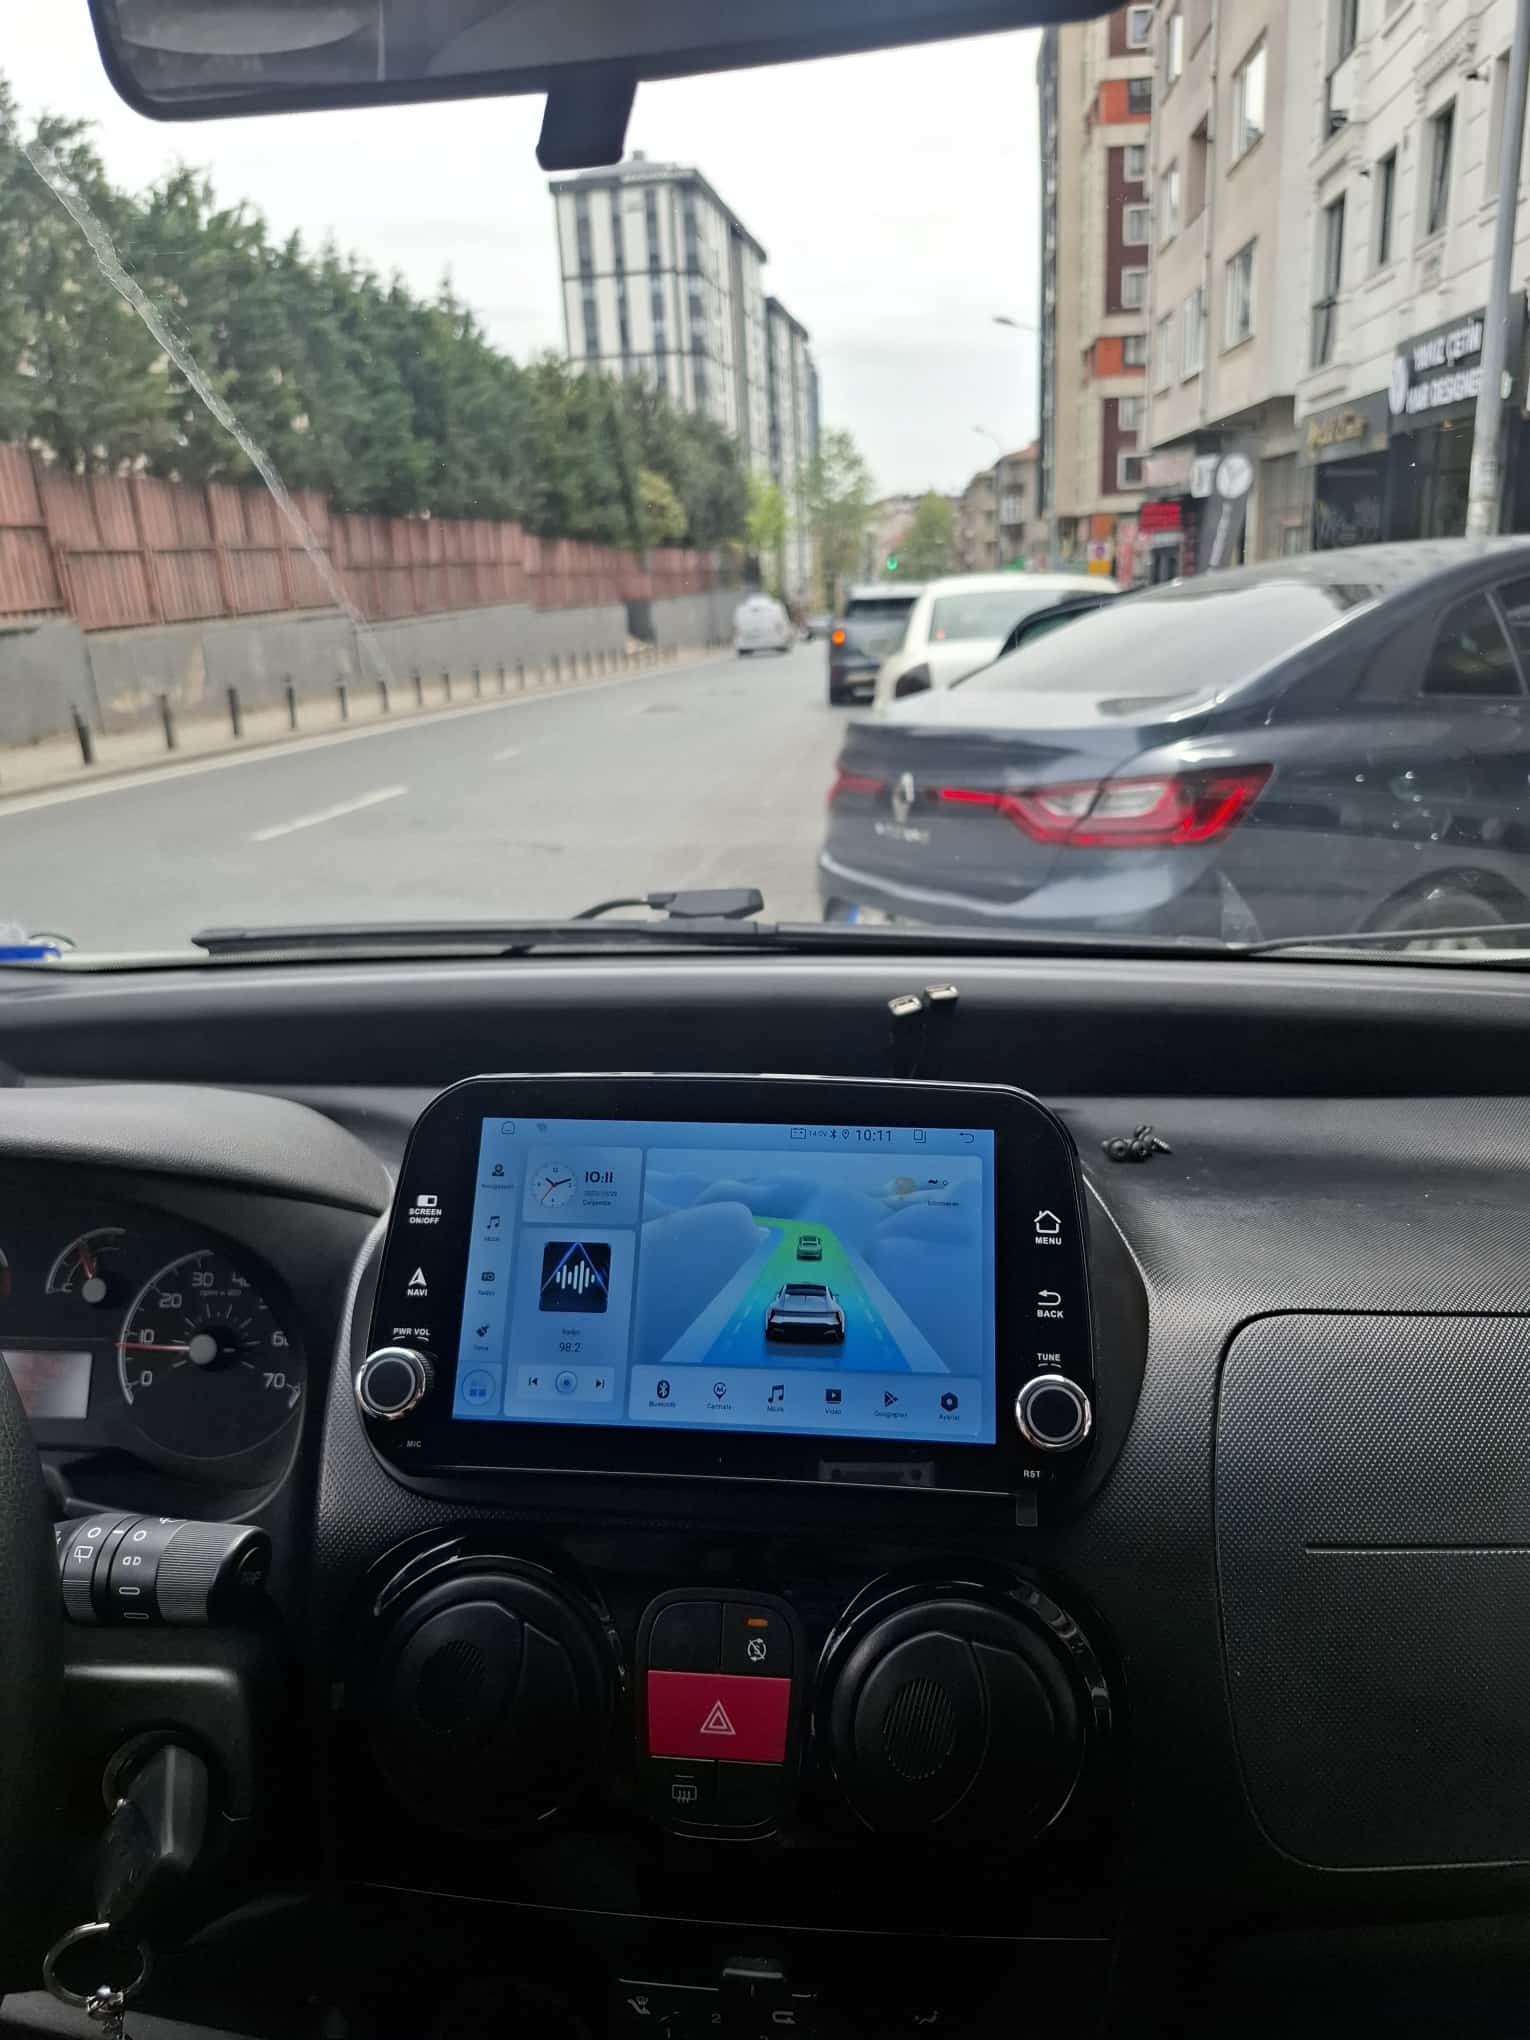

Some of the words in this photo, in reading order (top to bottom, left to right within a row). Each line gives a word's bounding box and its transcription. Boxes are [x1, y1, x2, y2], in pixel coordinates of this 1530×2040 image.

[856, 1129, 892, 1142] 10:11
[585, 1171, 614, 1184] 10:11
[409, 1208, 442, 1216] SCREEN
[409, 1217, 440, 1225] ON/OFF
[1035, 1236, 1062, 1245] MENU
[192, 1272, 214, 1288] 30
[407, 1289, 428, 1297] NAVI
[159, 1293, 182, 1309] 20
[1037, 1309, 1064, 1318] BACK
[393, 1328, 412, 1336] PWR
[414, 1328, 431, 1336] VOL
[559, 1342, 581, 1353] 98.2
[1037, 1353, 1061, 1361] TUNE
[141, 1371, 153, 1385] 0
[263, 1373, 286, 1388] 70
[406, 1440, 422, 1448] MIC
[1023, 1470, 1040, 1478] RST
